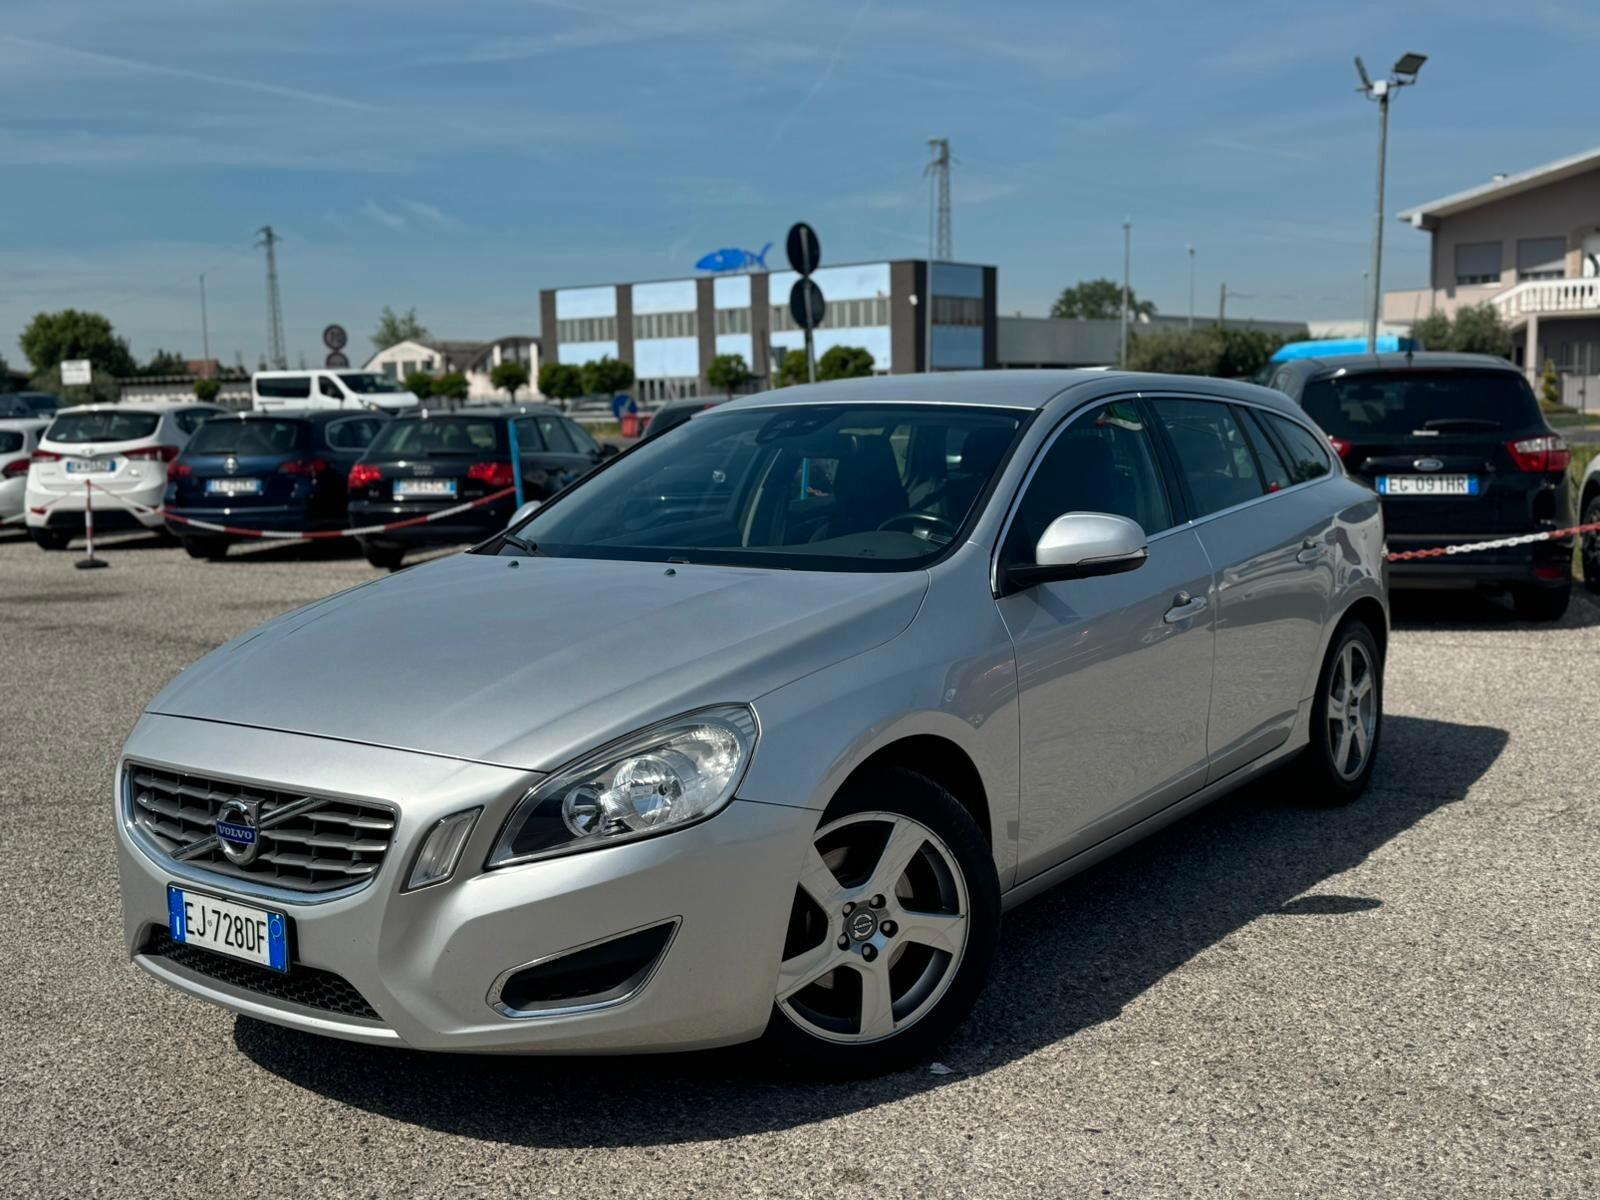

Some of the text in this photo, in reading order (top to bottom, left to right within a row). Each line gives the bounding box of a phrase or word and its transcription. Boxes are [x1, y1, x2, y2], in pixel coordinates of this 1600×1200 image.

[1390, 476, 1467, 493] EG 091HR
[218, 825, 252, 840] VOLVO
[184, 902, 267, 954] EJ 728DF
